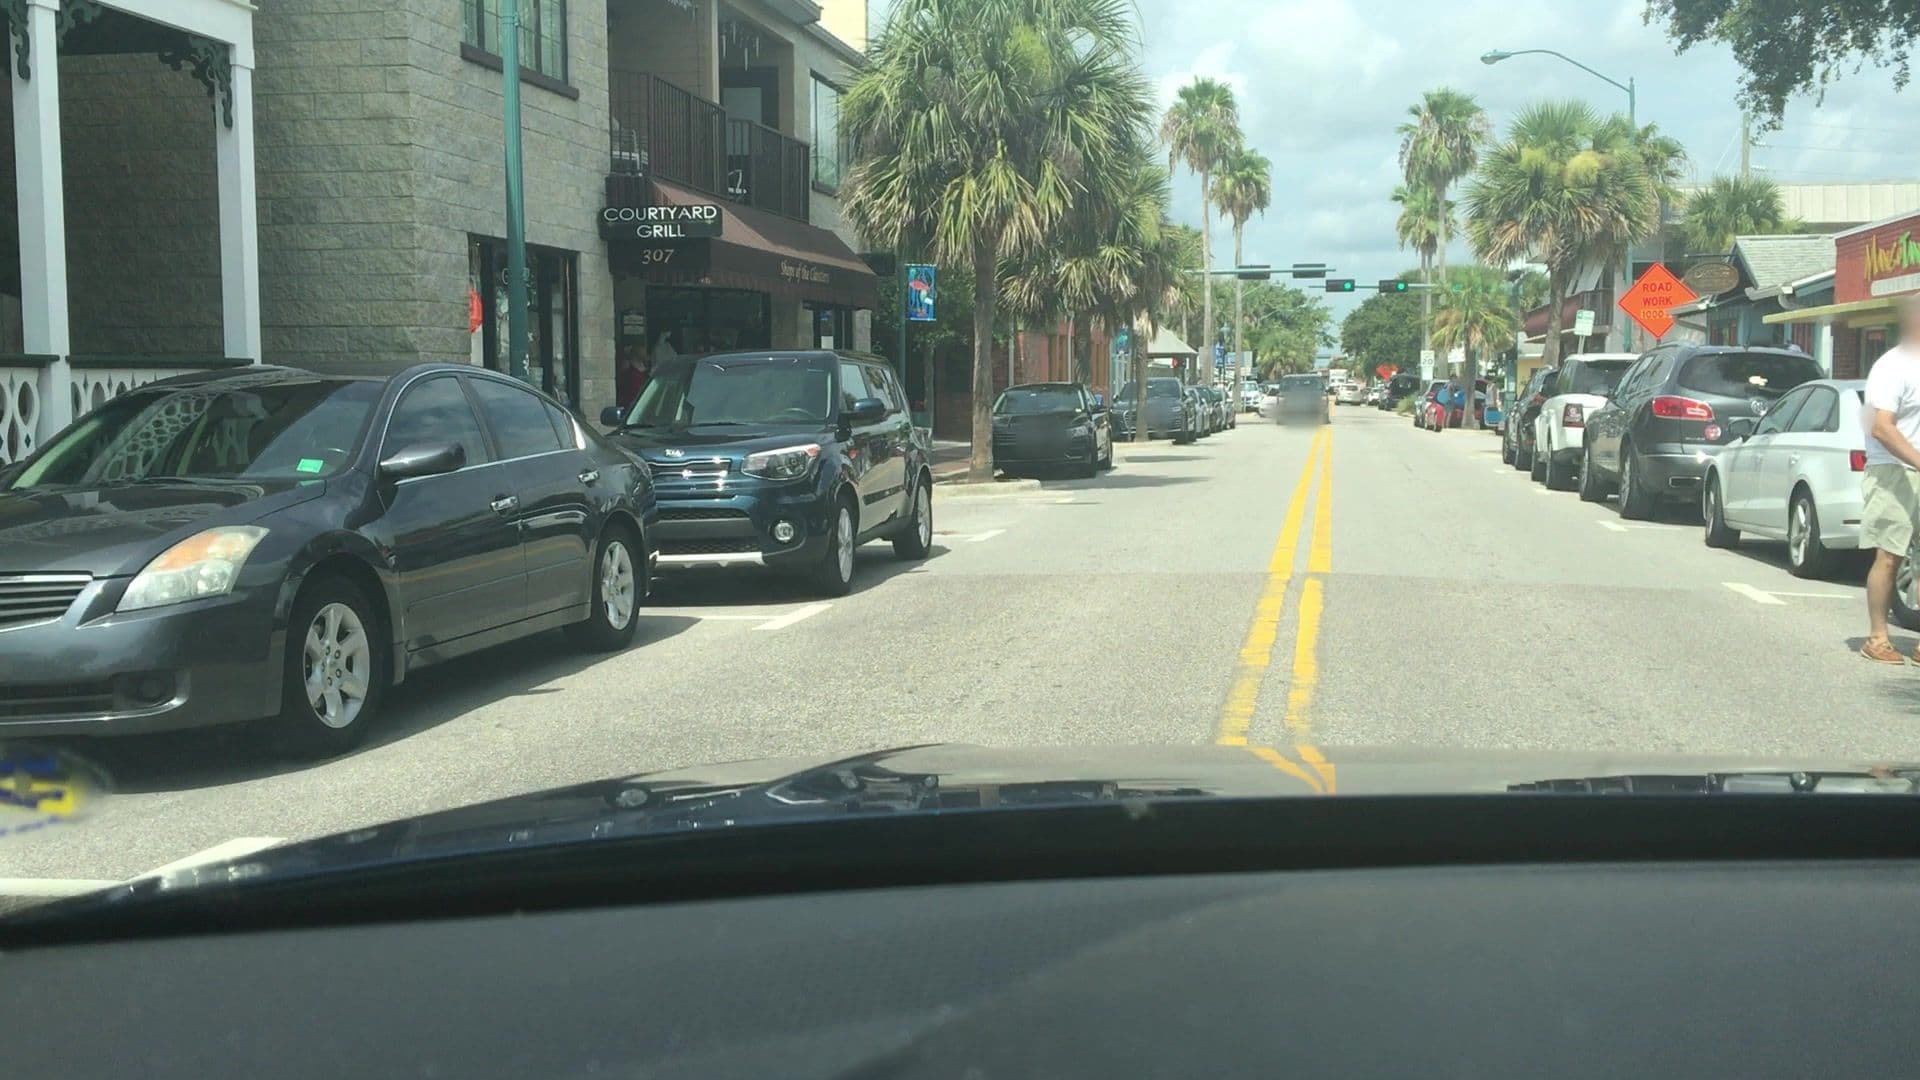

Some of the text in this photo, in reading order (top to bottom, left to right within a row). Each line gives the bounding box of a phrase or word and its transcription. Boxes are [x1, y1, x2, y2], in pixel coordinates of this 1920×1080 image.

[603, 205, 717, 221] COURTYARD
[636, 224, 685, 238] GRILL
[642, 249, 674, 264] 307
[1642, 282, 1672, 292] ROAD
[1642, 296, 1672, 306] WORK
